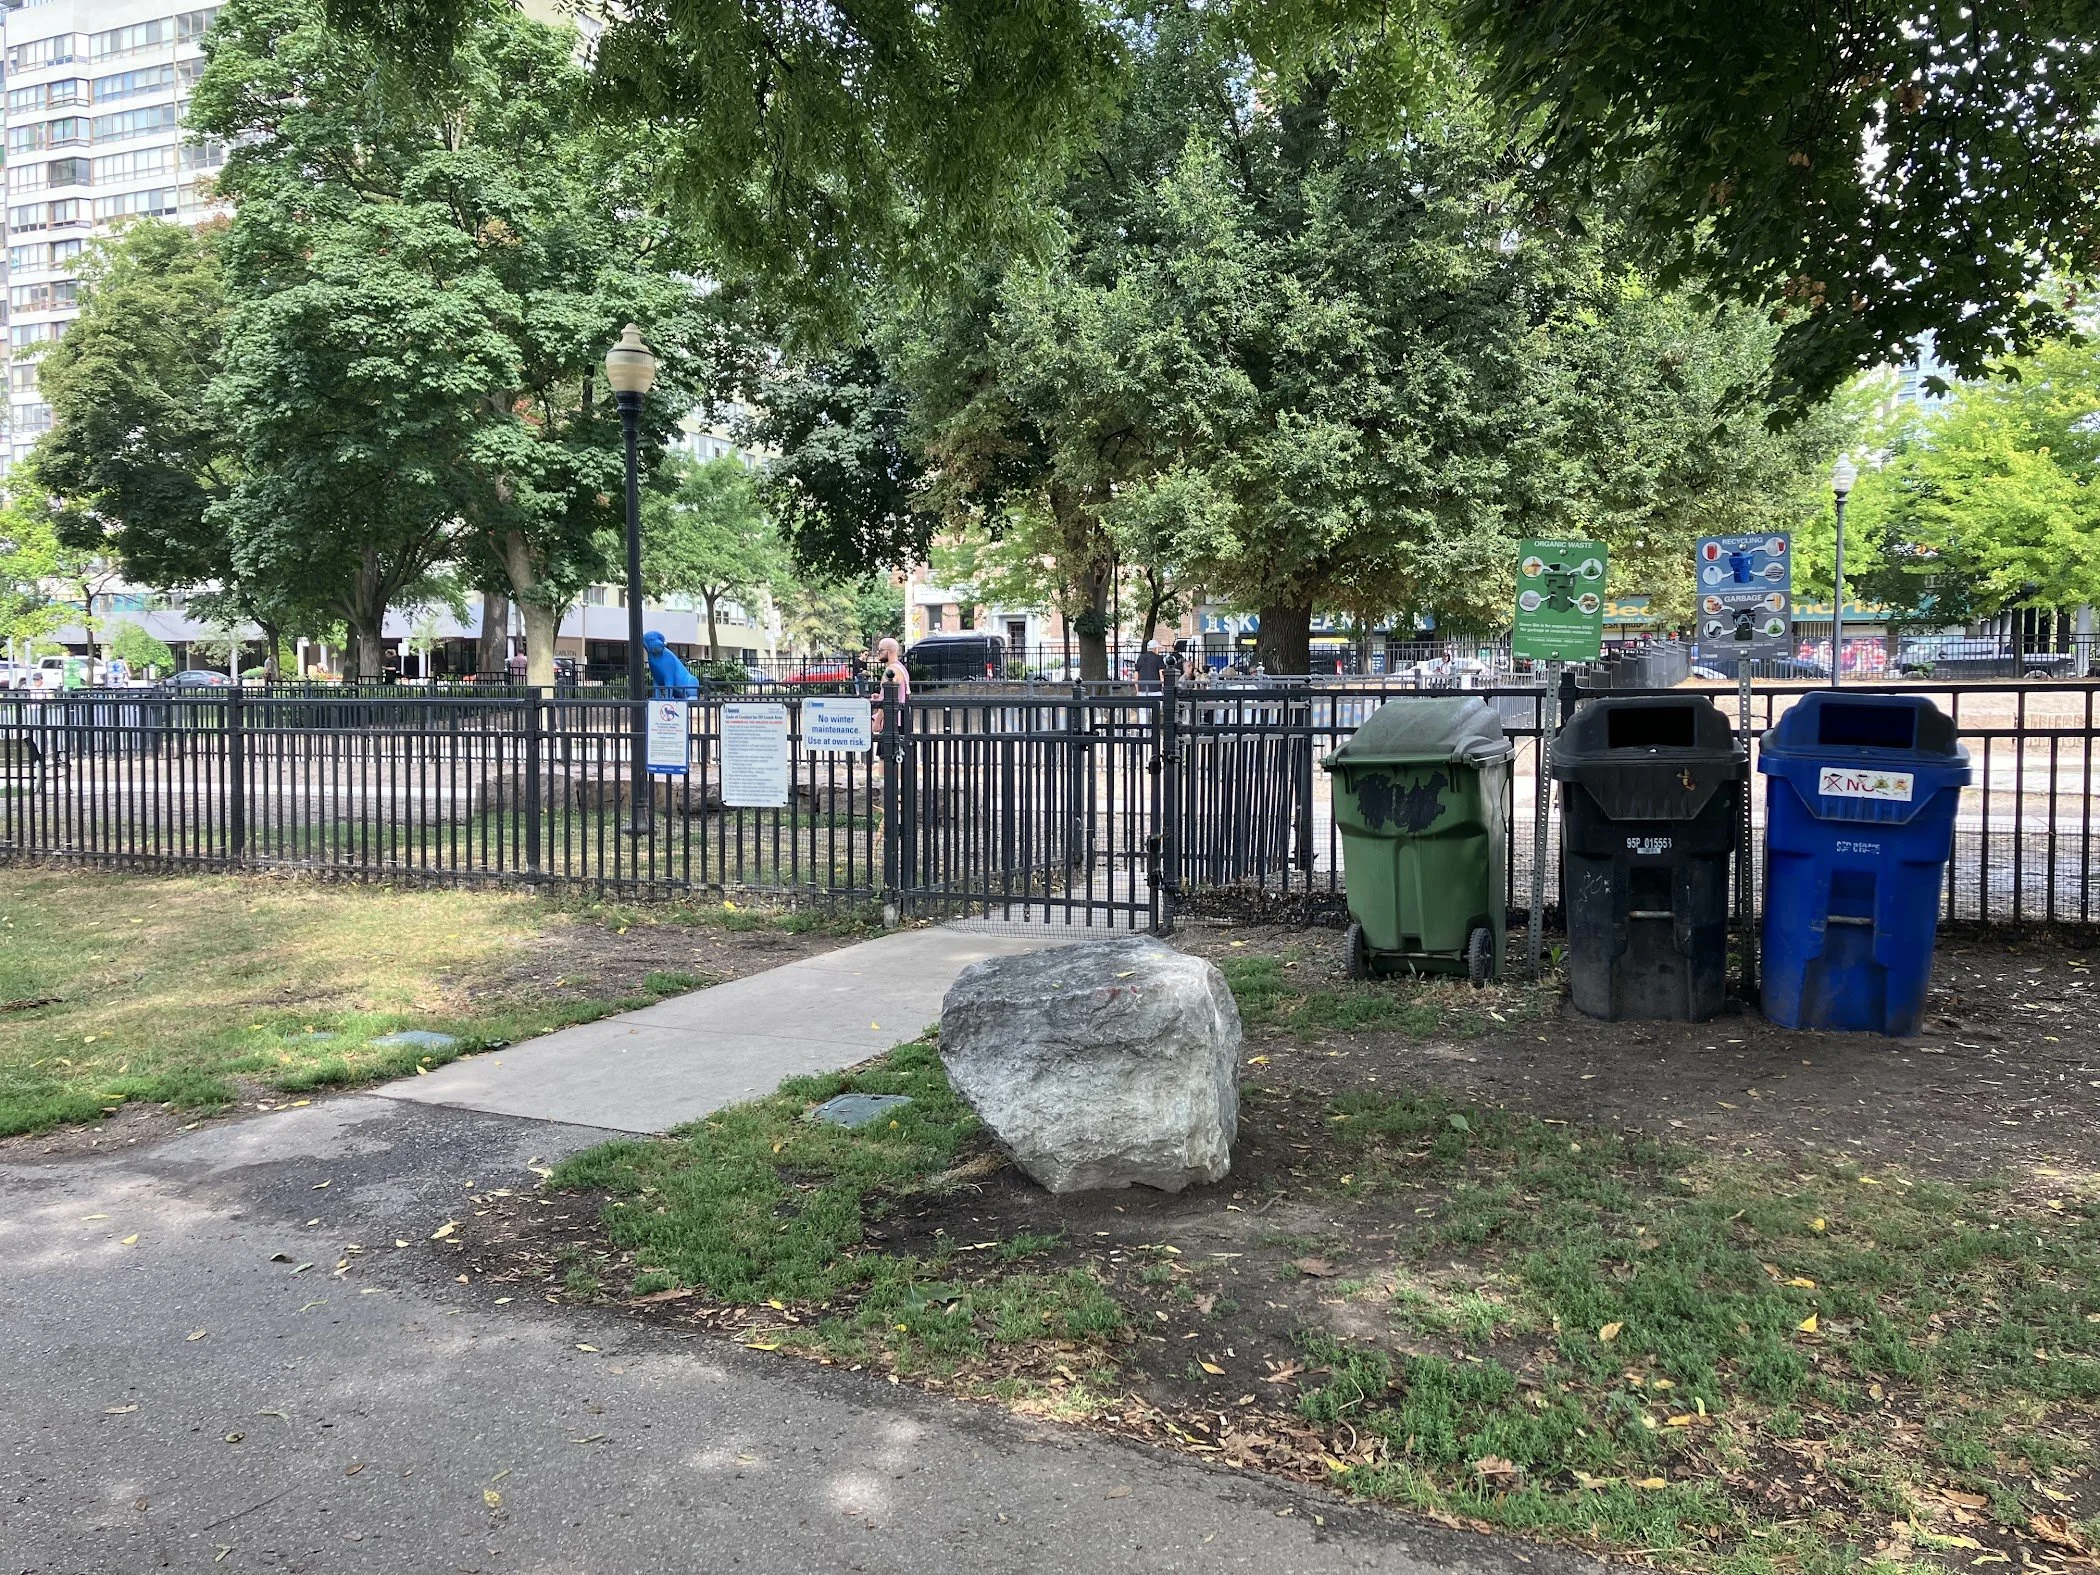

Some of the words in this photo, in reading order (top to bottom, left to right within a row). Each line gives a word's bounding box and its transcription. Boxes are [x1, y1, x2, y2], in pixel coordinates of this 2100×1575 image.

[1722, 537, 1764, 545] RECYCLING
[1724, 595, 1763, 603] GARBAGE
[818, 714, 829, 722] No
[830, 715, 854, 723] winter
[811, 725, 861, 734] maintenance.
[808, 736, 821, 744] Use
[850, 737, 866, 746] risk.
[1626, 838, 1641, 848] 95P
